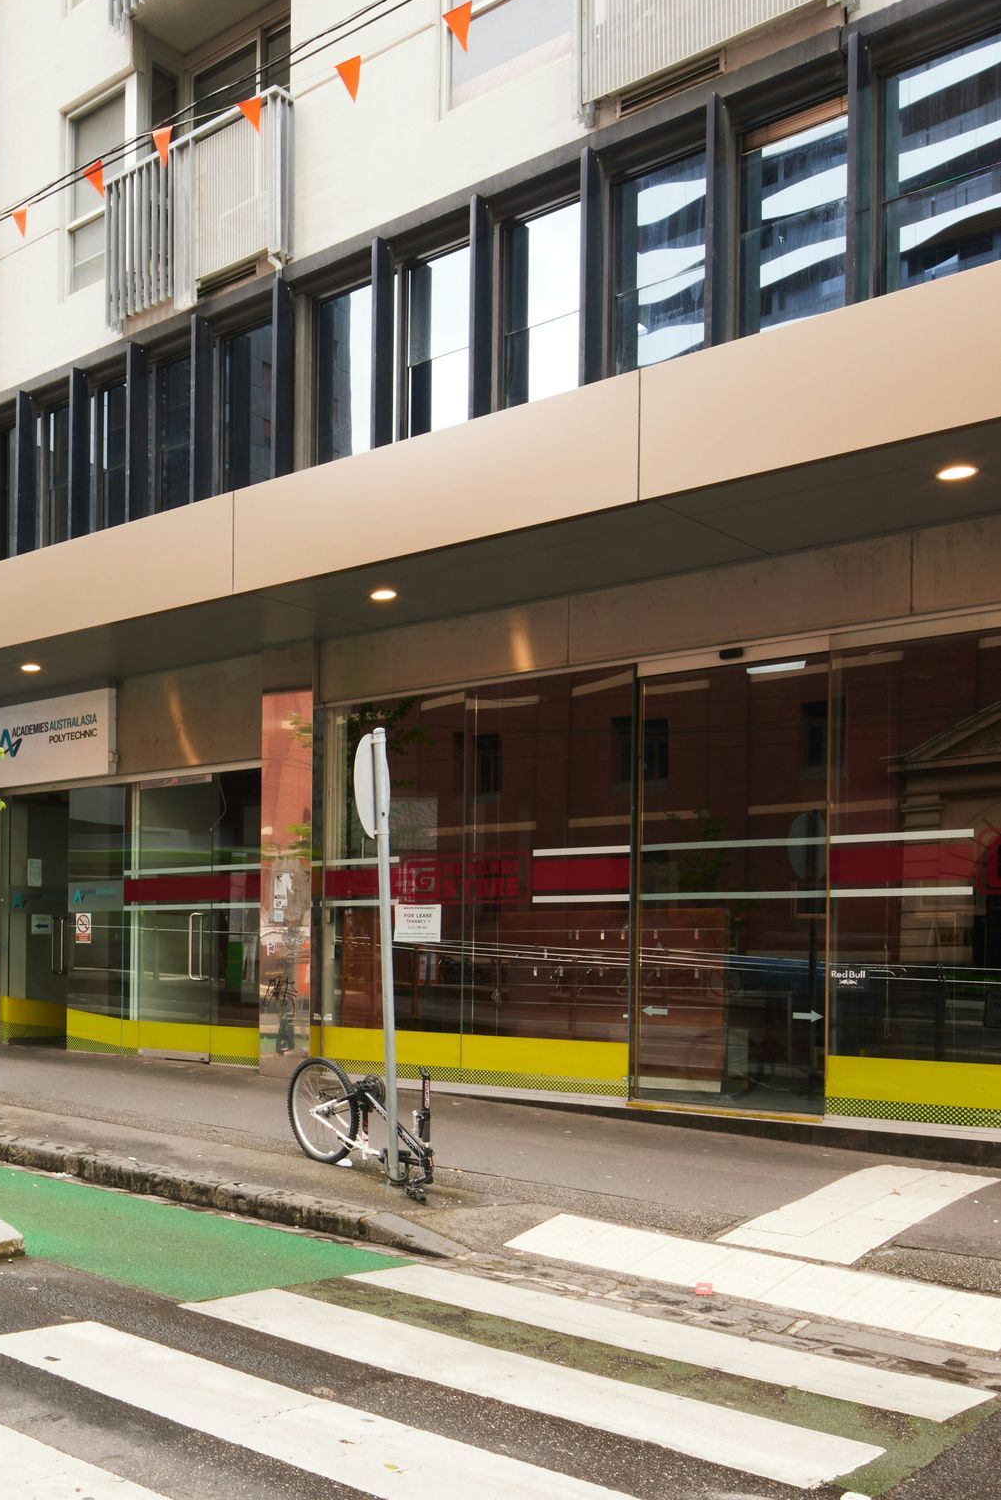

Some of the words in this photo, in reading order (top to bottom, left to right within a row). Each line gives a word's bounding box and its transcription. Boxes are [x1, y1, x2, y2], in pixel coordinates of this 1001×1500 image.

[12, 721, 49, 737] ACADEMIES
[50, 713, 97, 731] AUSTRALASIA
[49, 728, 97, 744] POLYTECHNIC
[831, 970, 848, 978] Red
[849, 970, 866, 979] Bull
